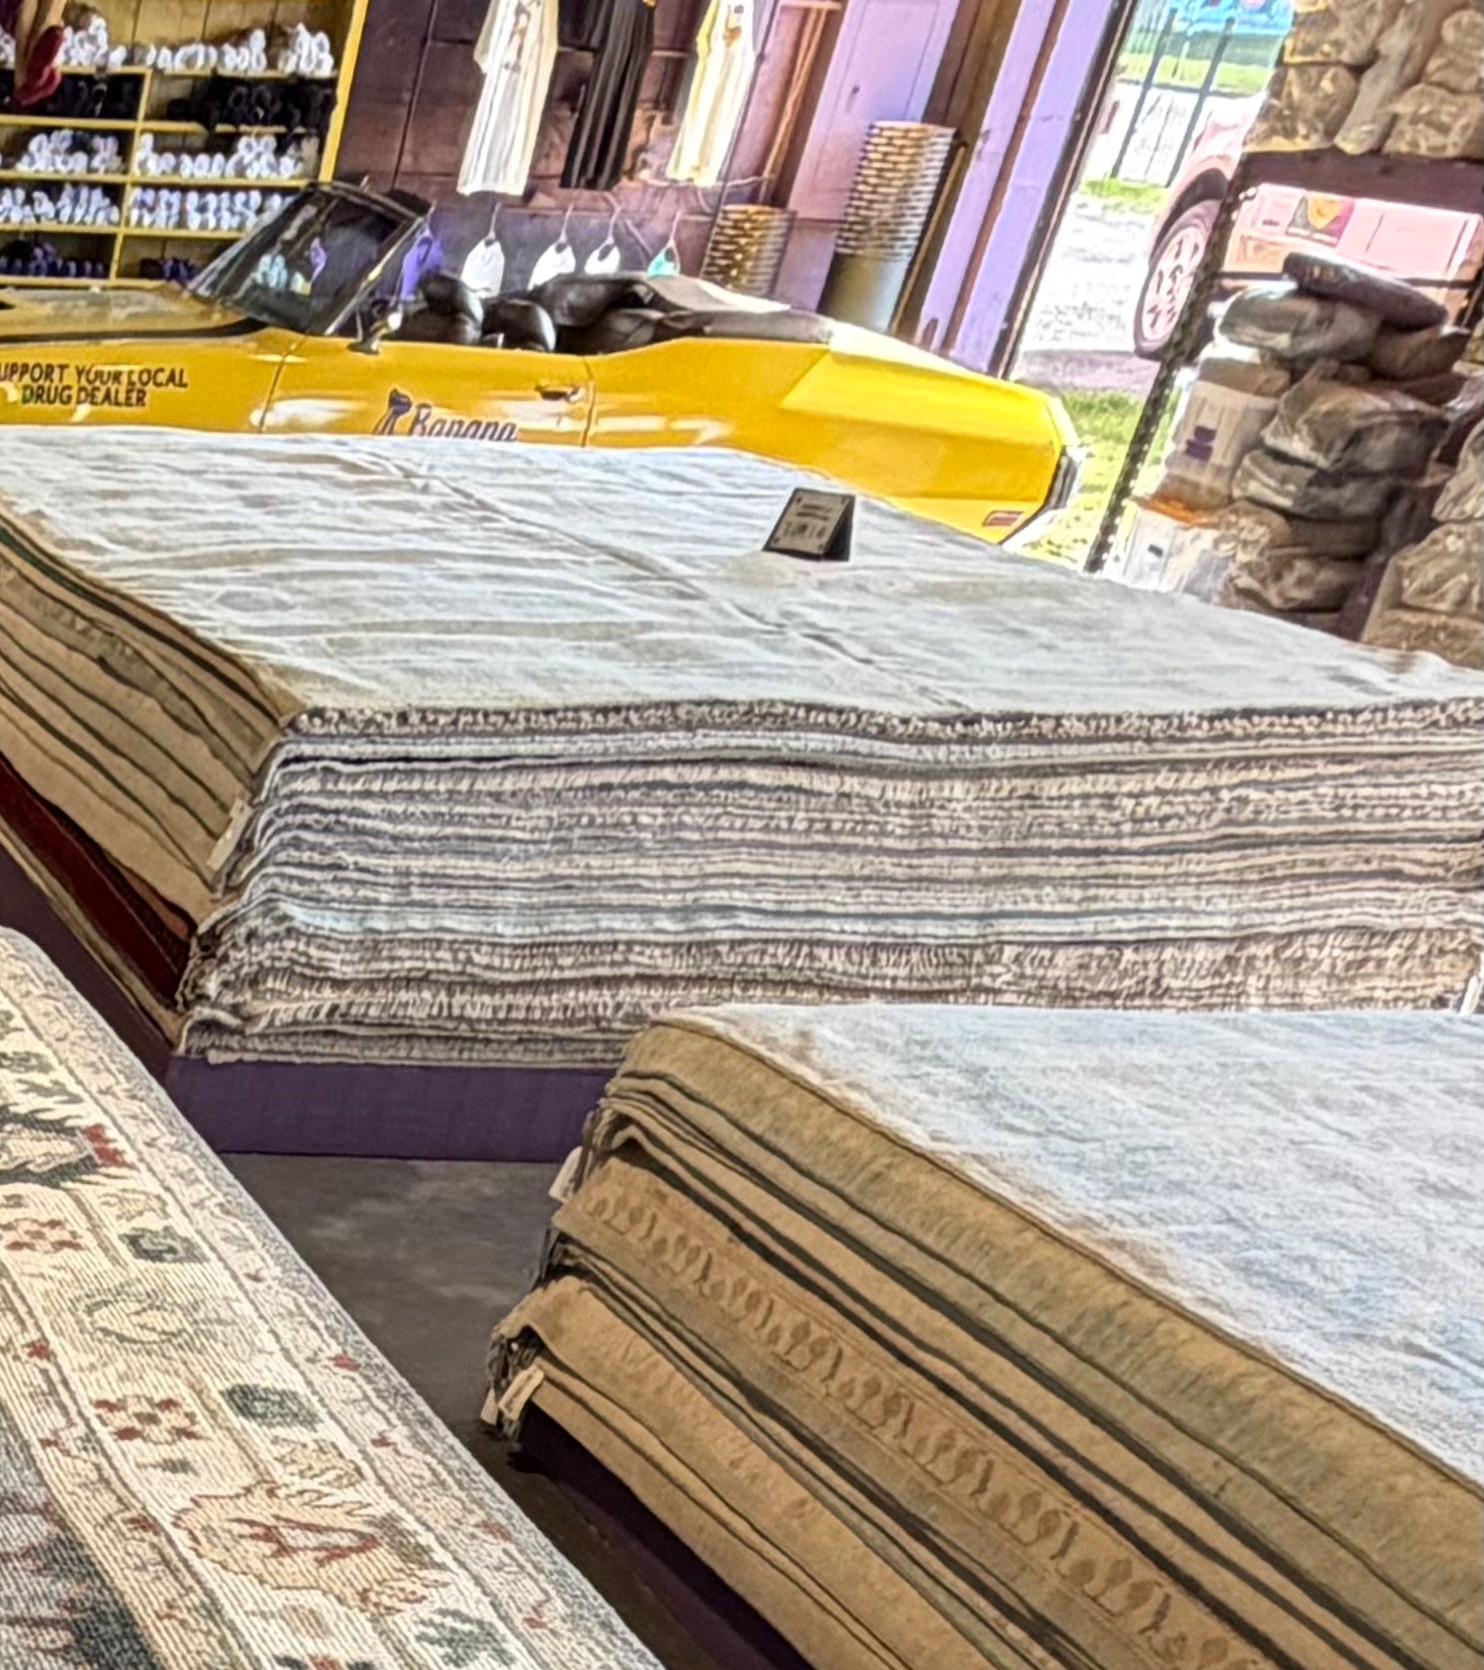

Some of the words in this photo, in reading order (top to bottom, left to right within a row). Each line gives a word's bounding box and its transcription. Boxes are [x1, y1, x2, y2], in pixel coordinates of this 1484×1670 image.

[74, 365, 124, 386] YOUR
[127, 367, 189, 388] LOCAL
[20, 384, 72, 405] DRUG
[76, 386, 147, 407] DEALER
[407, 402, 517, 442] Banana
